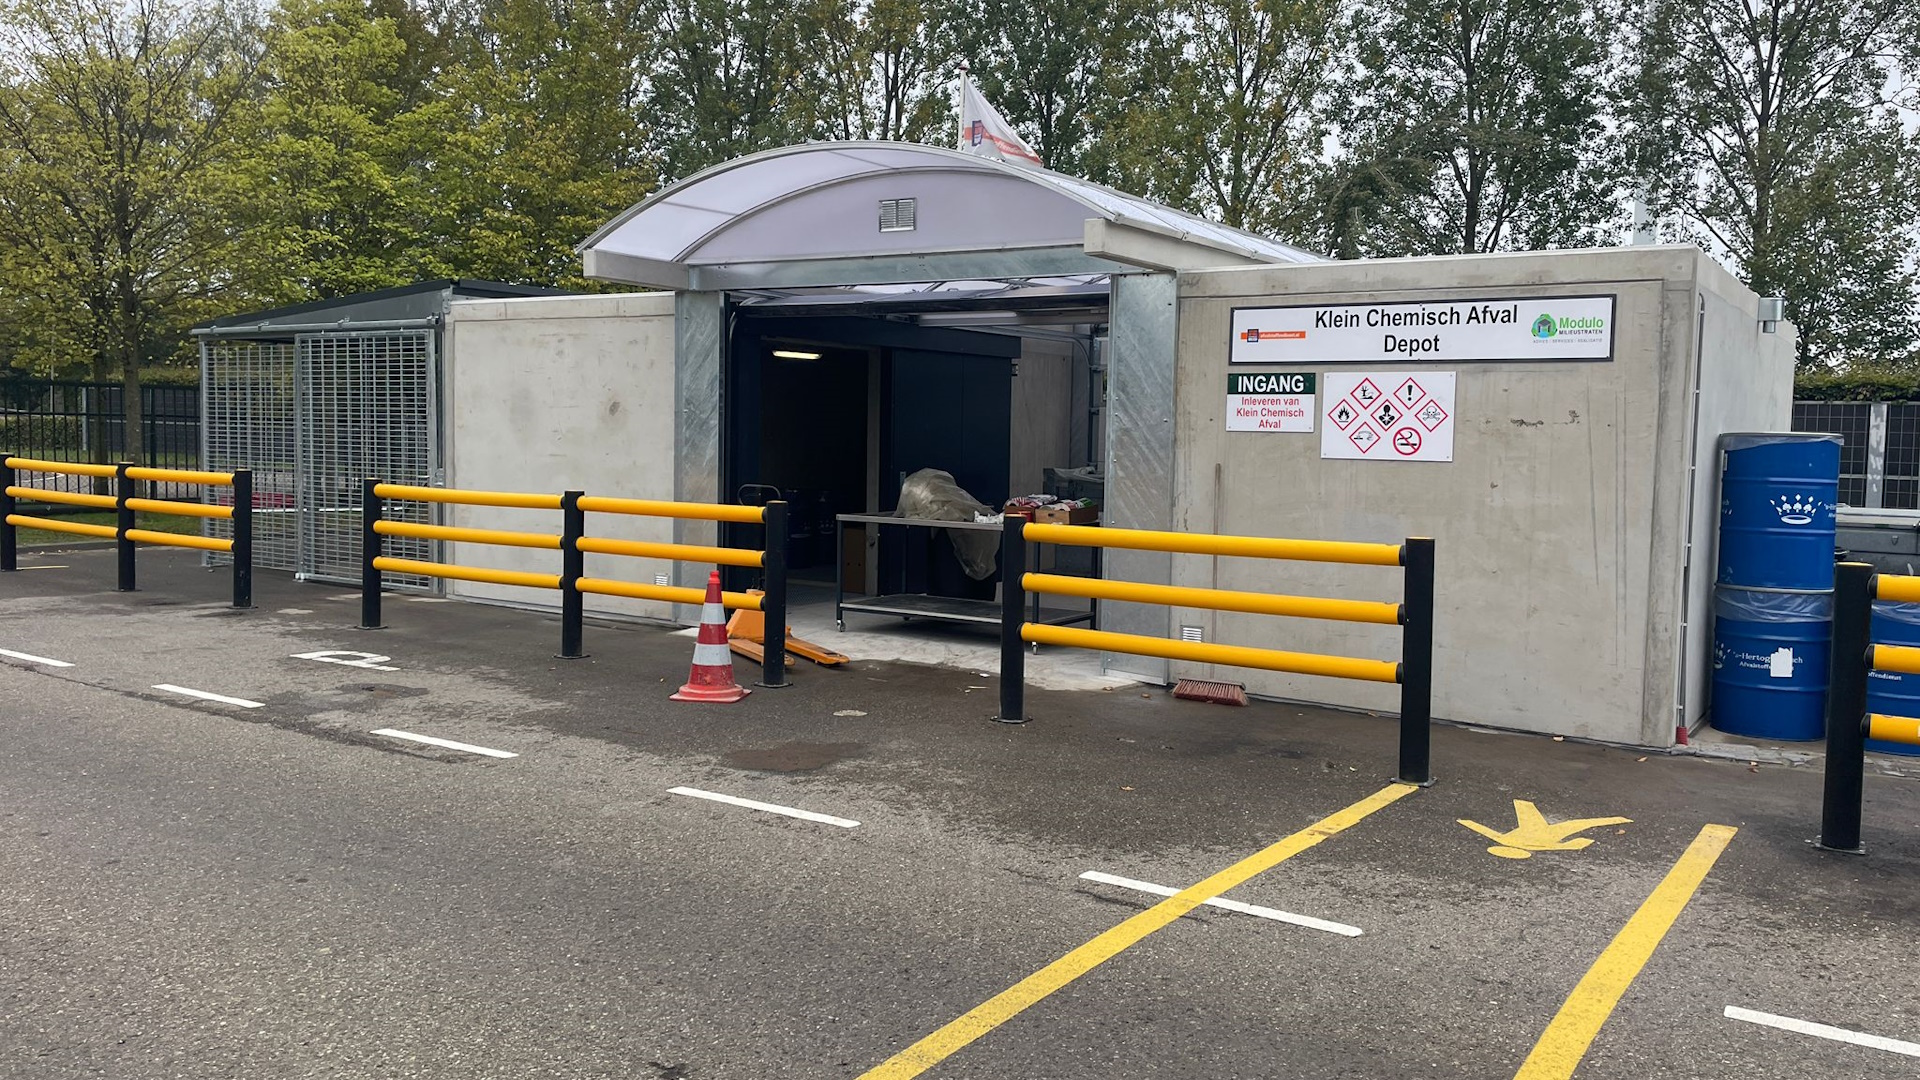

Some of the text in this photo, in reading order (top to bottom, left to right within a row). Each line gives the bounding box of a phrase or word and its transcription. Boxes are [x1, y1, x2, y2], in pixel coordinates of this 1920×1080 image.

[1315, 305, 1518, 328] Klein Chemisch Afval
[1559, 317, 1604, 329] Modulo
[1384, 334, 1440, 357] Depot
[1237, 375, 1304, 393] INGANG
[1241, 396, 1300, 406] Inleveren van
[1236, 407, 1304, 417] Klein Chemisch
[1258, 419, 1281, 429] Afval
